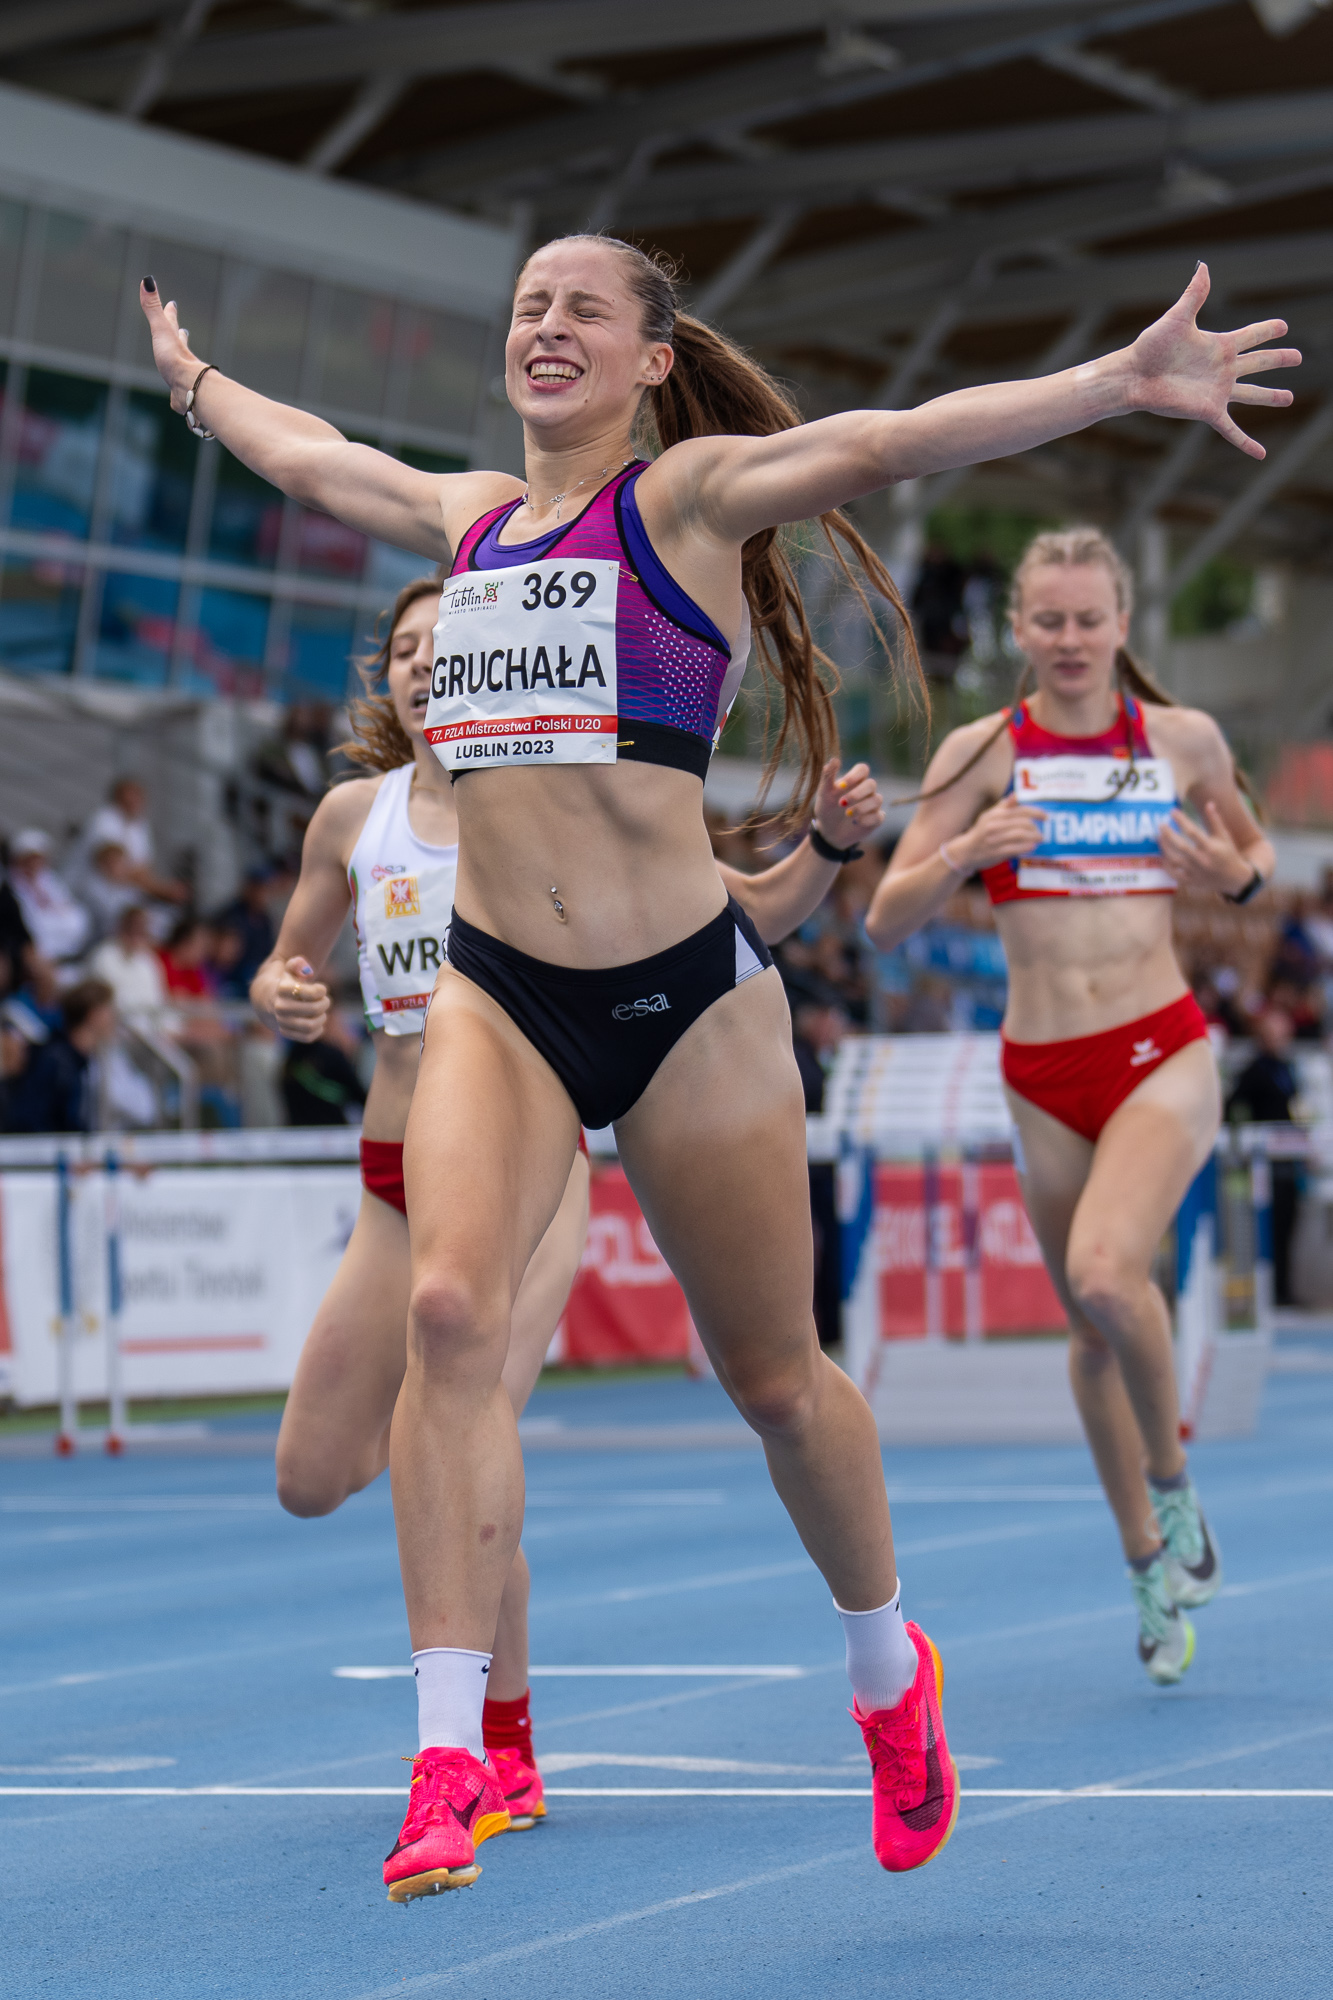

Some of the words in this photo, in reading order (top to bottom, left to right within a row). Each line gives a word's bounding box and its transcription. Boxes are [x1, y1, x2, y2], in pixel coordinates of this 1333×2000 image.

[522, 571, 597, 611] 369
[468, 604, 497, 612] INSPIRACJI
[432, 644, 607, 700] GRUCHAŁA
[431, 729, 443, 742] 77.
[444, 726, 464, 739] PZLA
[465, 720, 531, 736] Mistrzostwa
[534, 718, 572, 731] Polski
[575, 718, 602, 730] U20
[455, 742, 508, 760] LUBLIN
[512, 740, 554, 756] 2023
[386, 902, 418, 917] PZLA
[376, 936, 445, 976] WR
[402, 997, 424, 1007] PZLA
